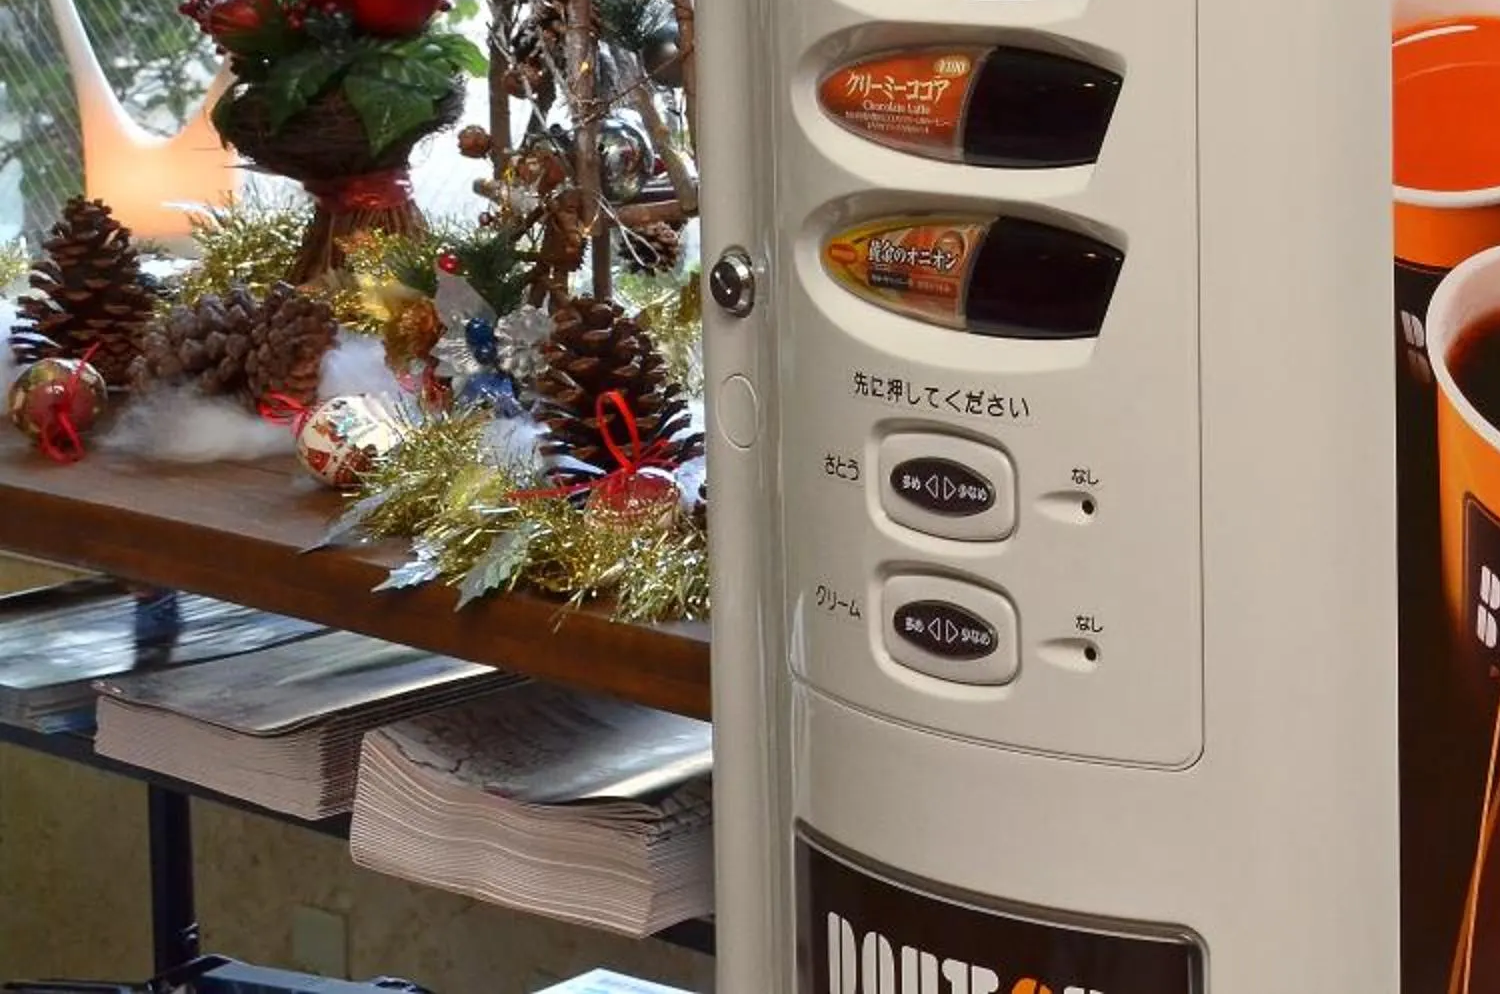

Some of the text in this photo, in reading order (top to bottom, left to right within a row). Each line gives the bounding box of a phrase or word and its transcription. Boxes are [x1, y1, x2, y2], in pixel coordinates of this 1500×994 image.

[846, 71, 951, 104] クリーミーココア
[853, 371, 1030, 418] 先に押してください
[824, 453, 860, 481] さとう
[1071, 467, 1100, 486] なし
[816, 585, 861, 619] クリーム
[1075, 614, 1104, 633] なし
[827, 911, 1106, 994] DOU
